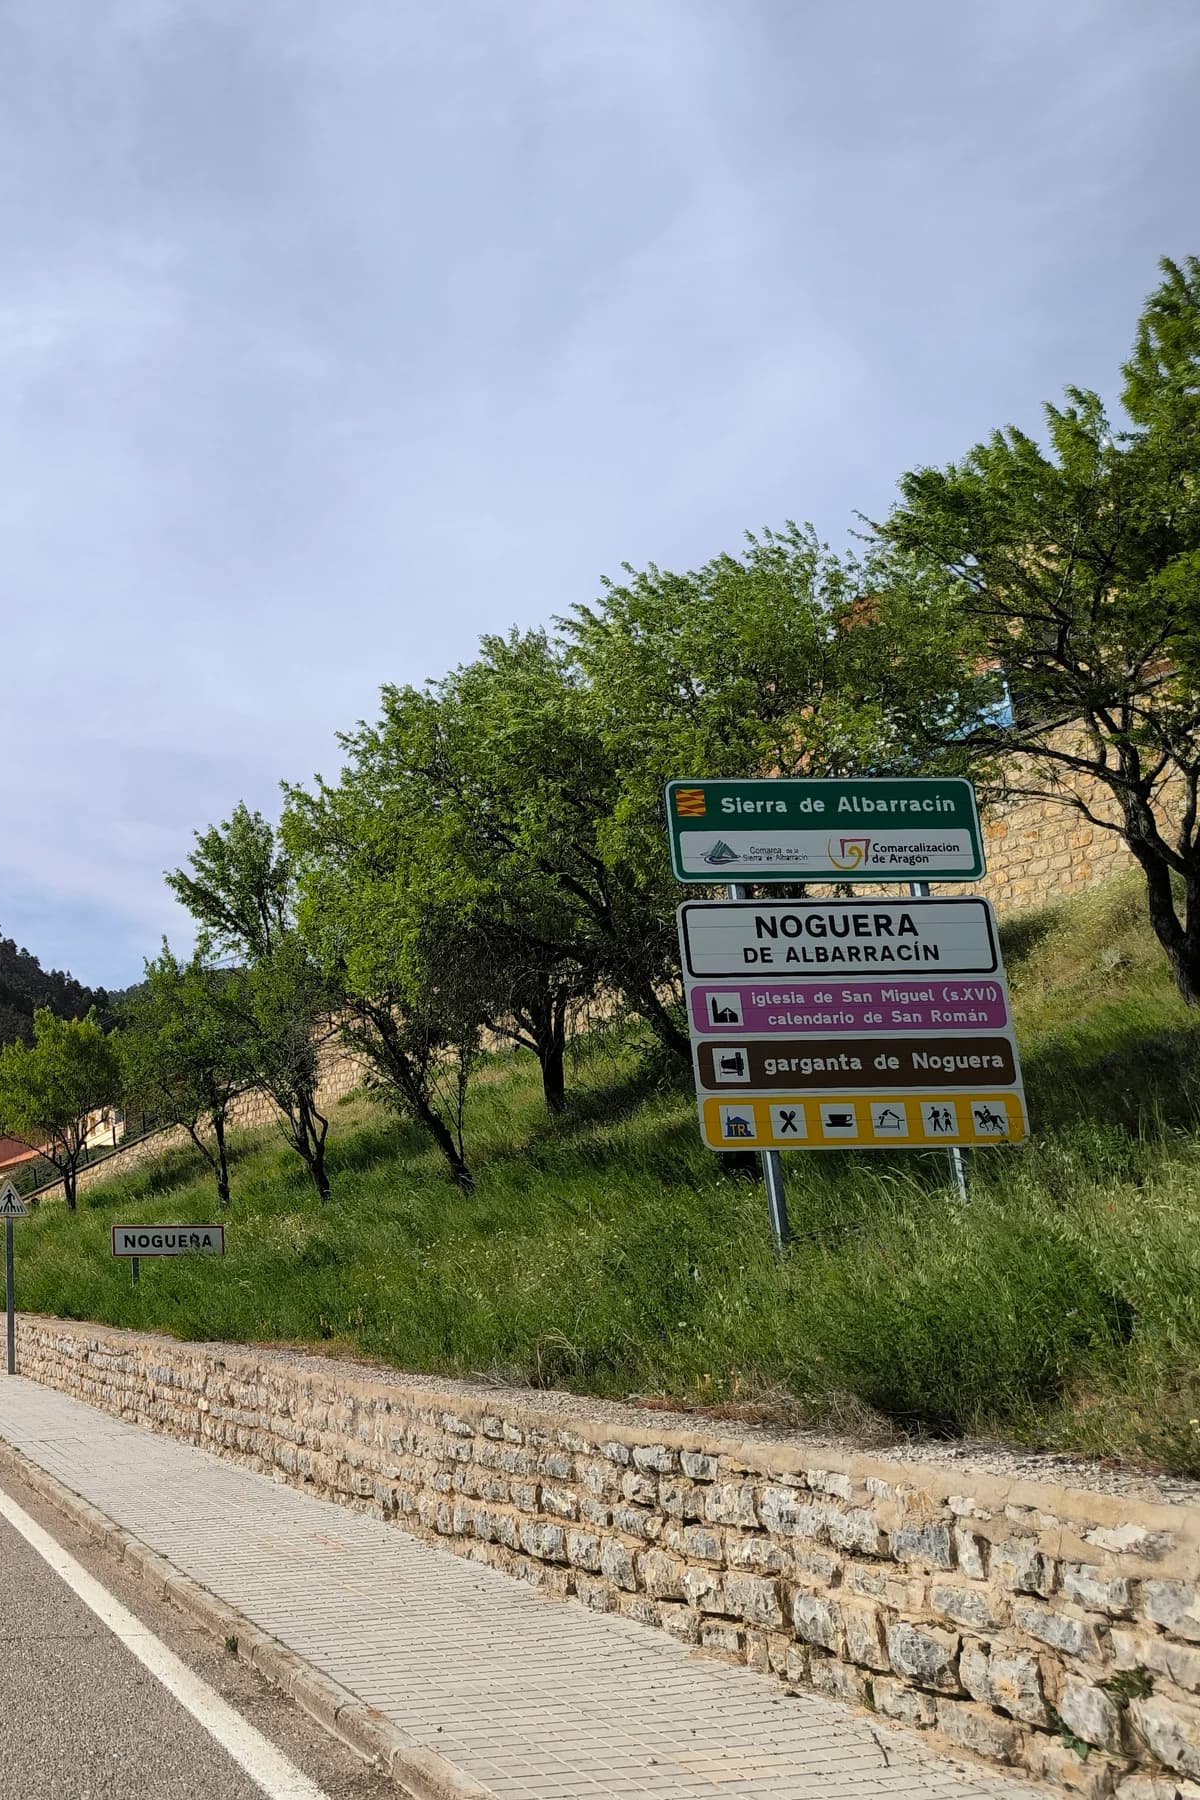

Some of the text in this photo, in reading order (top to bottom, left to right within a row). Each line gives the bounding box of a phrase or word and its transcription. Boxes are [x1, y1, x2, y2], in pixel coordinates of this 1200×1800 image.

[721, 795, 955, 813] Sierra de Albarracín
[750, 846, 782, 854] Comarca
[872, 842, 960, 853] Comarcalización
[872, 853, 929, 866] de Aragón
[755, 913, 919, 939] NOGUERA
[743, 941, 940, 963] DE ALBARRACÍN
[751, 991, 805, 1007] iglesia
[814, 991, 833, 1004] de
[841, 990, 872, 1004] San
[881, 988, 935, 1004] Miguel
[768, 1008, 988, 1025] calendario de San Román
[764, 1052, 1004, 1075] garganta de Noguera
[729, 1123, 745, 1136] TR
[123, 1234, 212, 1248] NOGUERA
